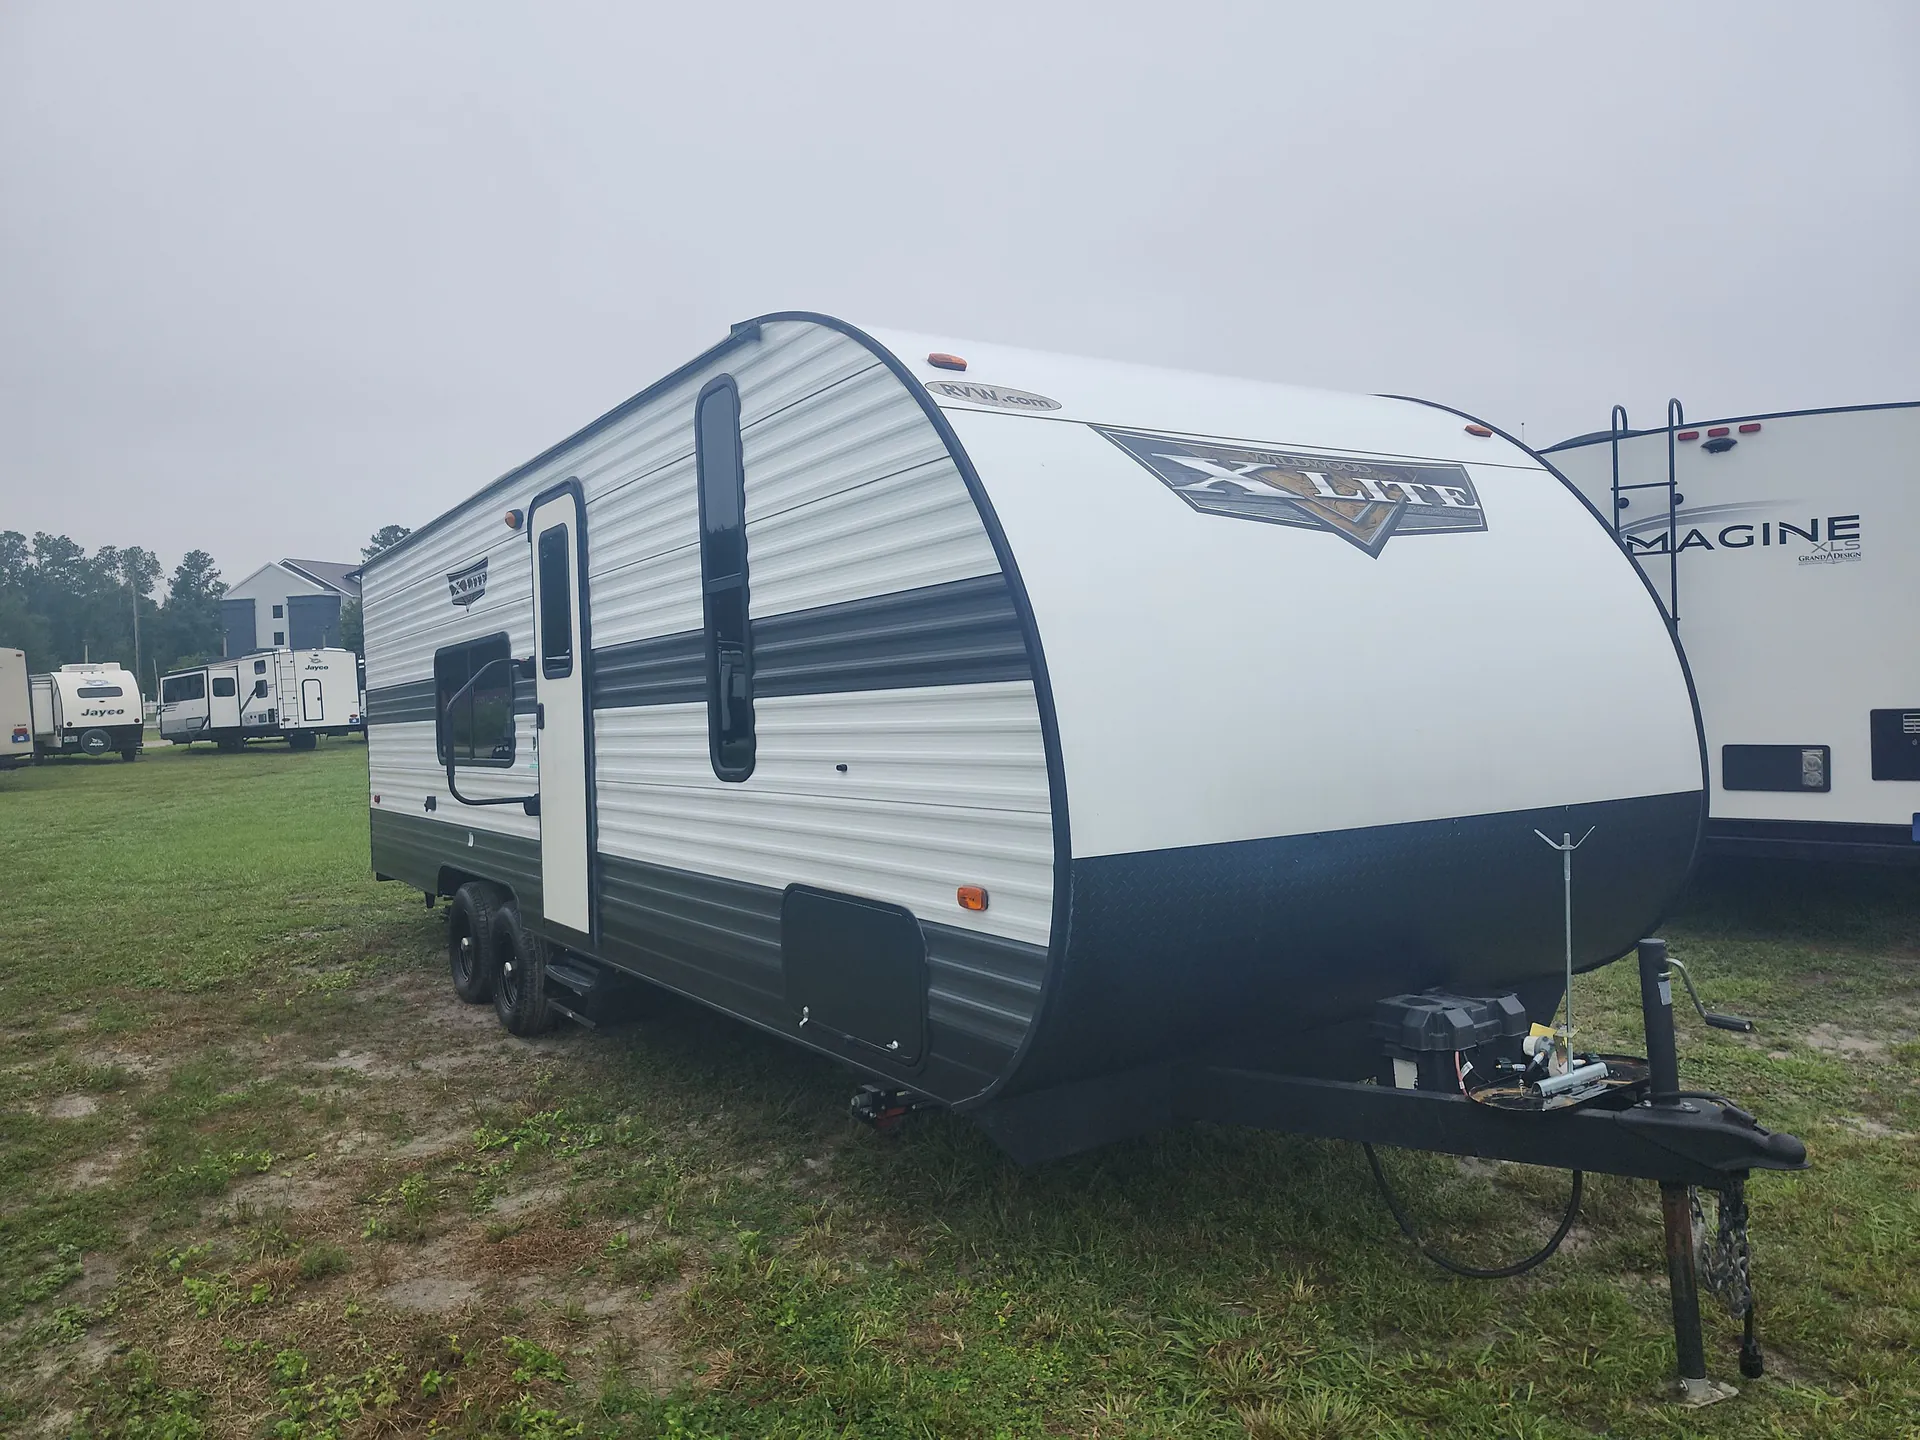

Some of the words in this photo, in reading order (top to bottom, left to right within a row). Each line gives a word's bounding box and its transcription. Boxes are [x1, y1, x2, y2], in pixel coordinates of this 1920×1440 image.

[939, 383, 1052, 409] RVW.com
[1252, 451, 1373, 474] WILDWOOD
[1625, 514, 1860, 556] MAGINE
[1811, 540, 1861, 553] XLS
[304, 664, 329, 672] Jayco
[81, 708, 124, 718] Jayco
